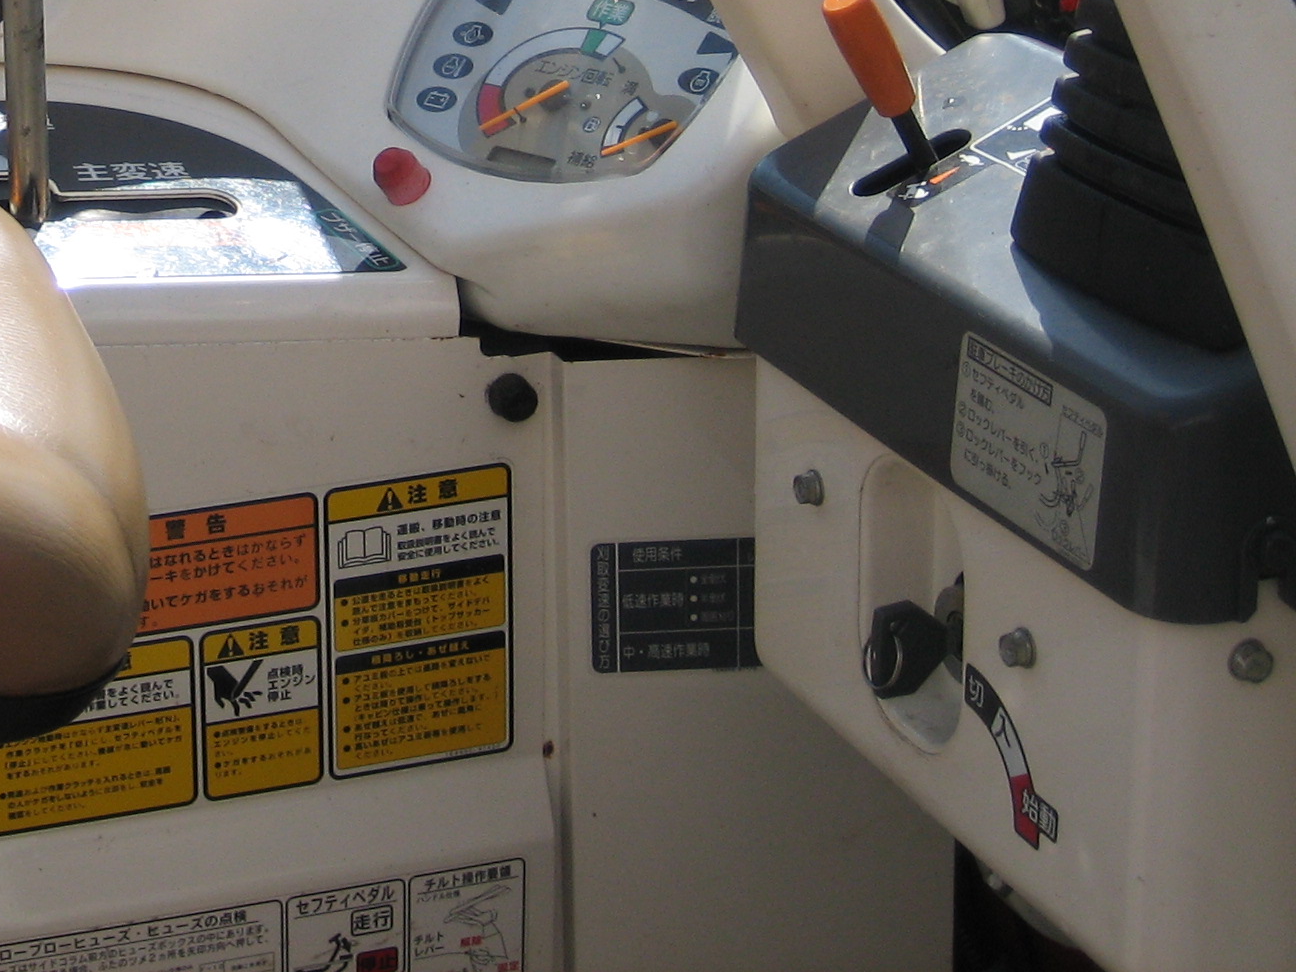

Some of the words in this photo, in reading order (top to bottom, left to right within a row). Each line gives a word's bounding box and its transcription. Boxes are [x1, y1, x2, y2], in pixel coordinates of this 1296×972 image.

[72, 159, 192, 183] 主変速
[407, 478, 458, 505] 注意
[248, 624, 301, 651] 注意
[102, 678, 174, 699] をよく読んで
[266, 674, 316, 691] エンジン
[968, 674, 984, 708] 切
[266, 690, 292, 703] 停止
[993, 713, 1012, 749] 入
[1021, 788, 1056, 839] 始動
[295, 884, 396, 916] セフティペダル
[353, 909, 392, 931] 走行
[413, 931, 445, 945] チルト
[414, 944, 445, 957] レバー
